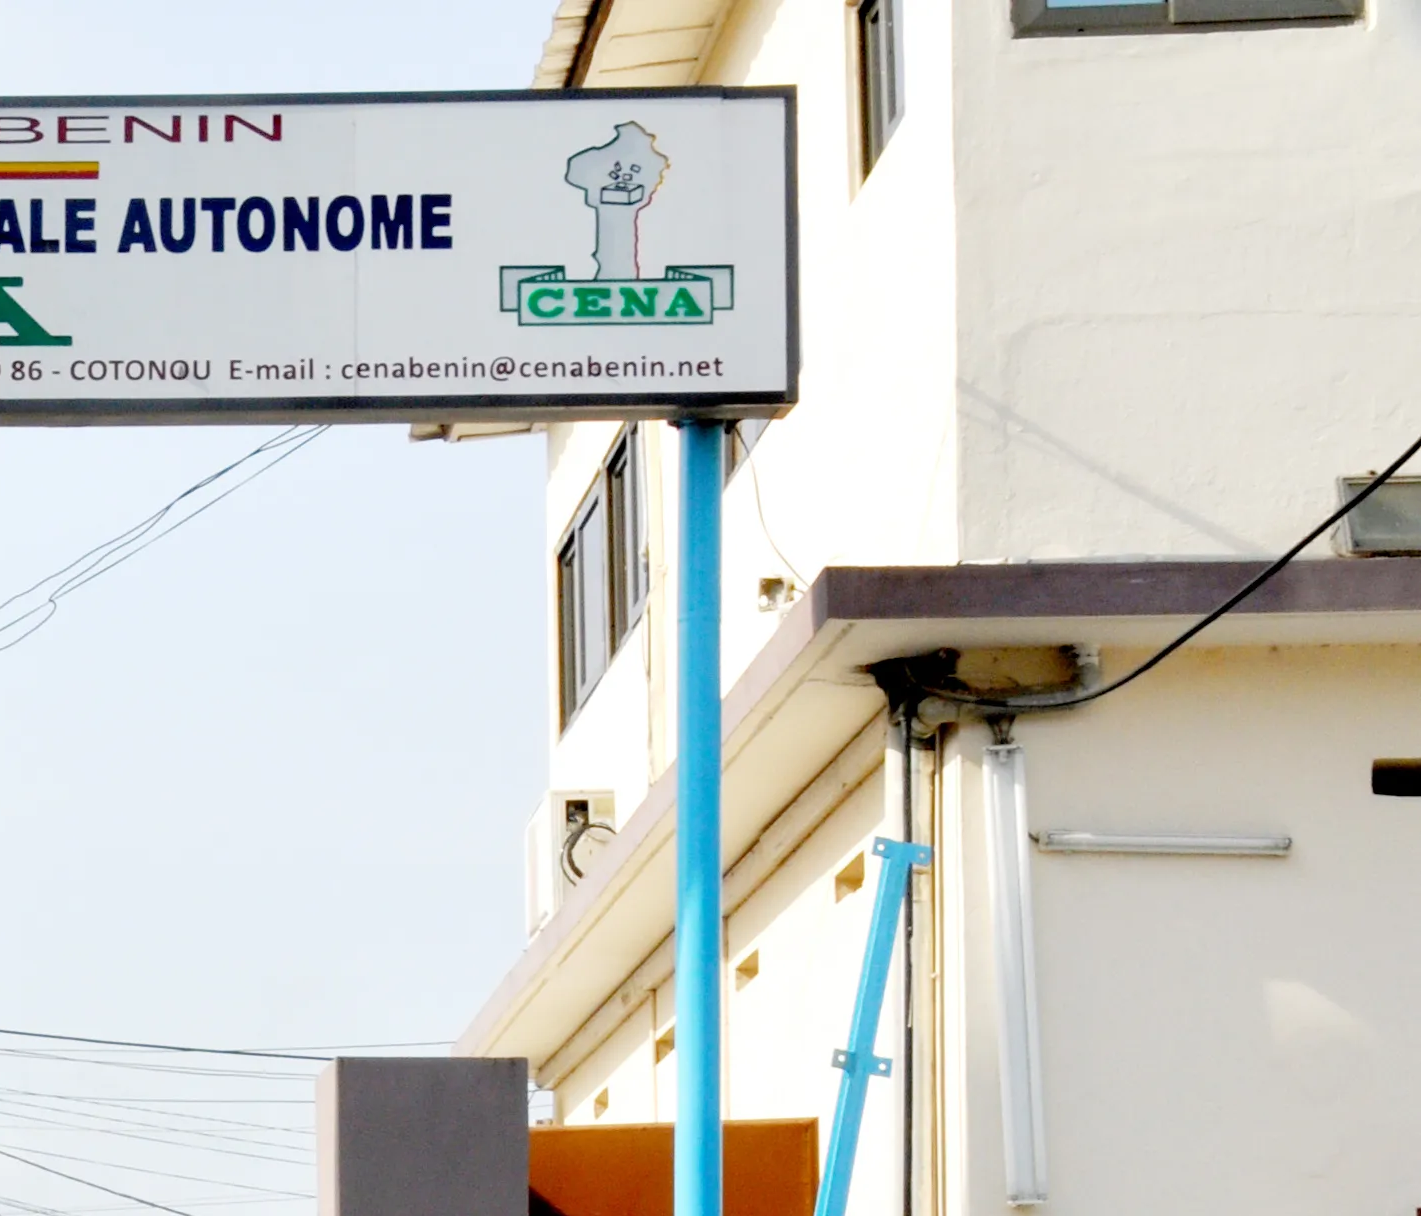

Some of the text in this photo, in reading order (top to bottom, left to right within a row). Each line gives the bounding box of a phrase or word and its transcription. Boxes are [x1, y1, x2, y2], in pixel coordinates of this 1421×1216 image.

[117, 194, 453, 254] AUTONOME
[527, 287, 705, 318] CENA
[10, 359, 43, 382] 86
[69, 359, 211, 382] COTONOU
[229, 357, 314, 381] E-mail
[341, 355, 724, 382] cenabenin@cenabenin.net
